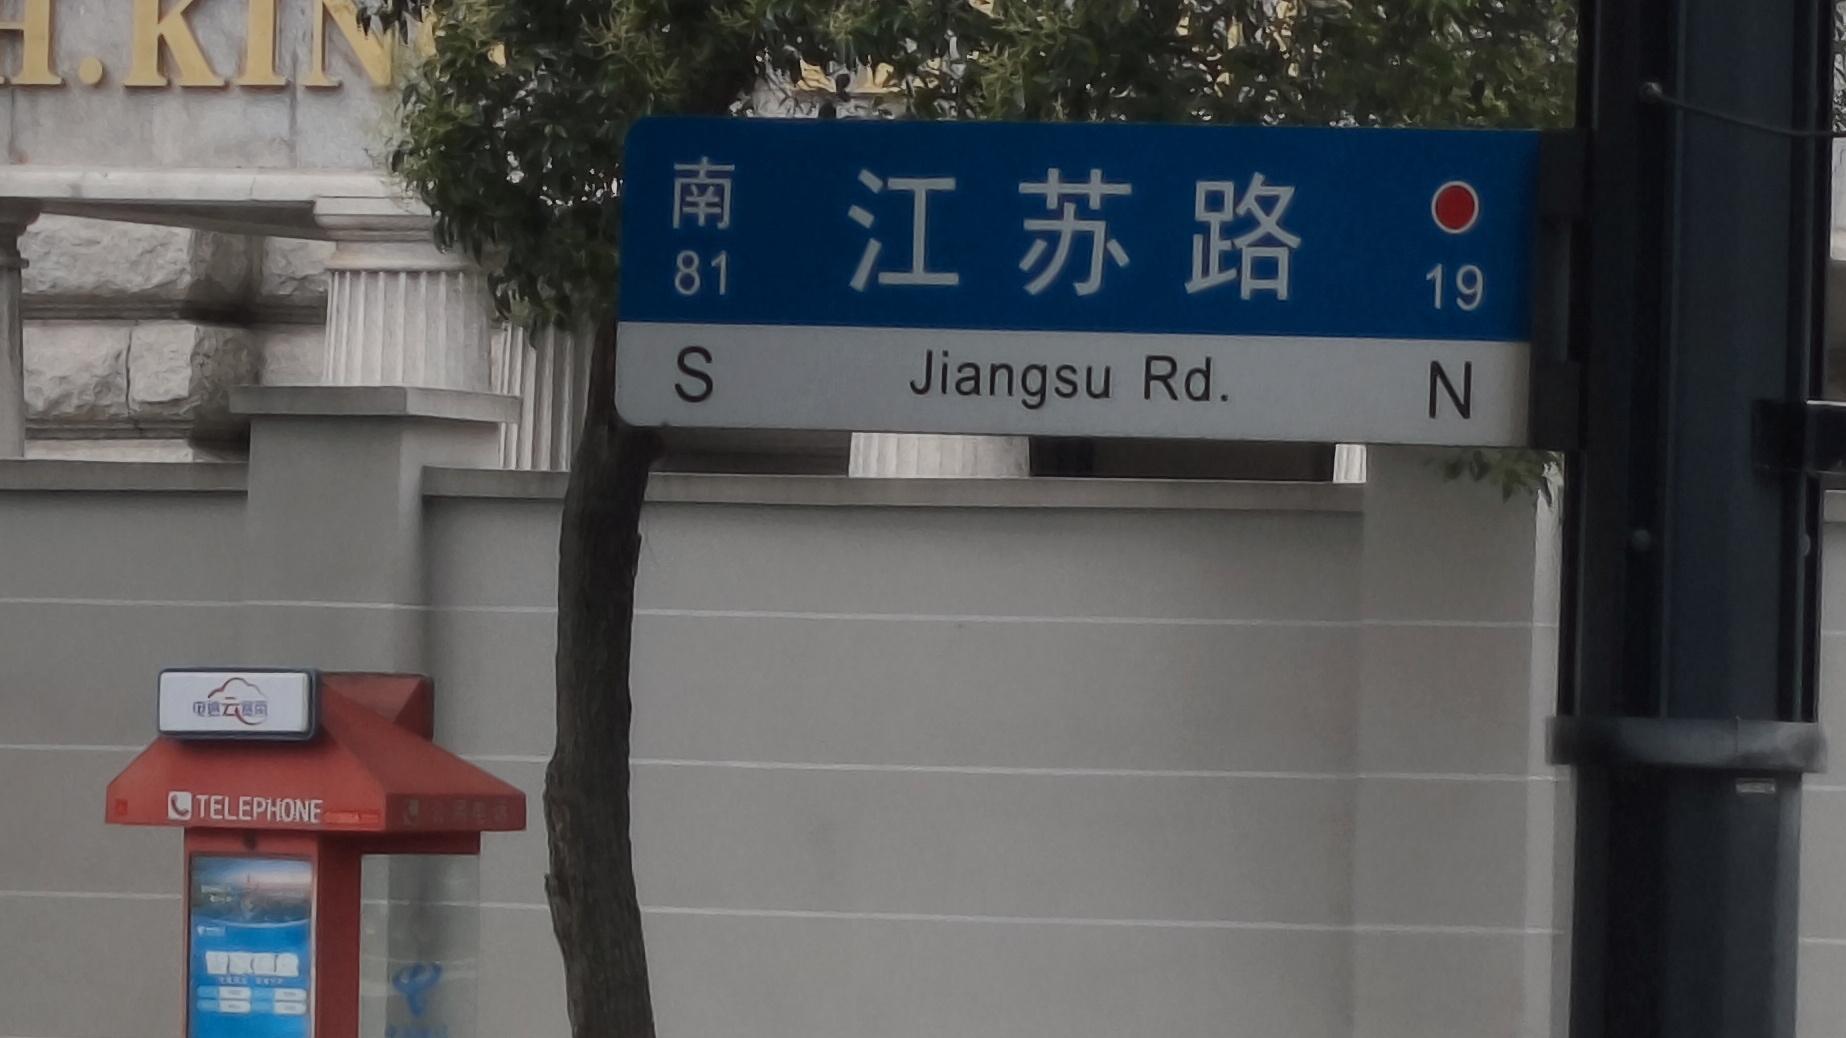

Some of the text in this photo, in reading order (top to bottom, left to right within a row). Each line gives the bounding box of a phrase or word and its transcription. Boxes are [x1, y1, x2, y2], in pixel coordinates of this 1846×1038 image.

[672, 156, 735, 230] 南
[849, 167, 1302, 301] 江苏路
[674, 250, 728, 297] 81
[1425, 264, 1484, 311] 19
[673, 344, 715, 404] S
[909, 349, 1230, 411] Jiangsu Rd.
[1428, 360, 1473, 420] N
[196, 794, 323, 824] TELEPHONE
